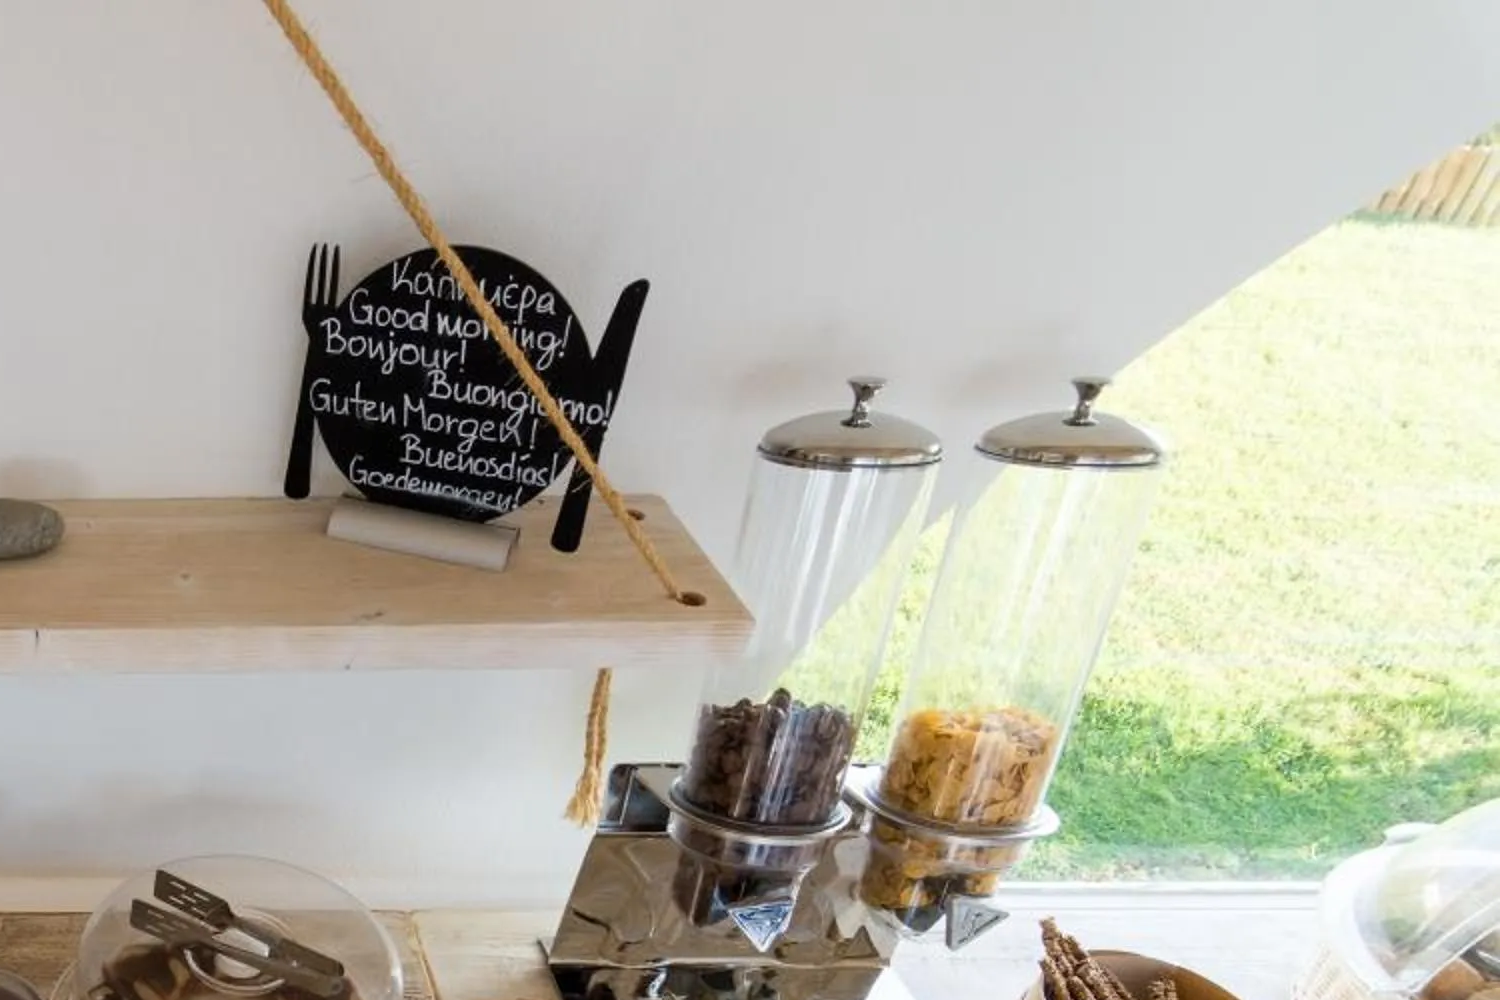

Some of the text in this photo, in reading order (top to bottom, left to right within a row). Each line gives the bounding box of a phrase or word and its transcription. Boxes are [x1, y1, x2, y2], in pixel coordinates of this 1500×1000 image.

[320, 316, 467, 375] Bonjour!
[350, 288, 573, 371] Good moring!
[309, 378, 396, 423] Guten
